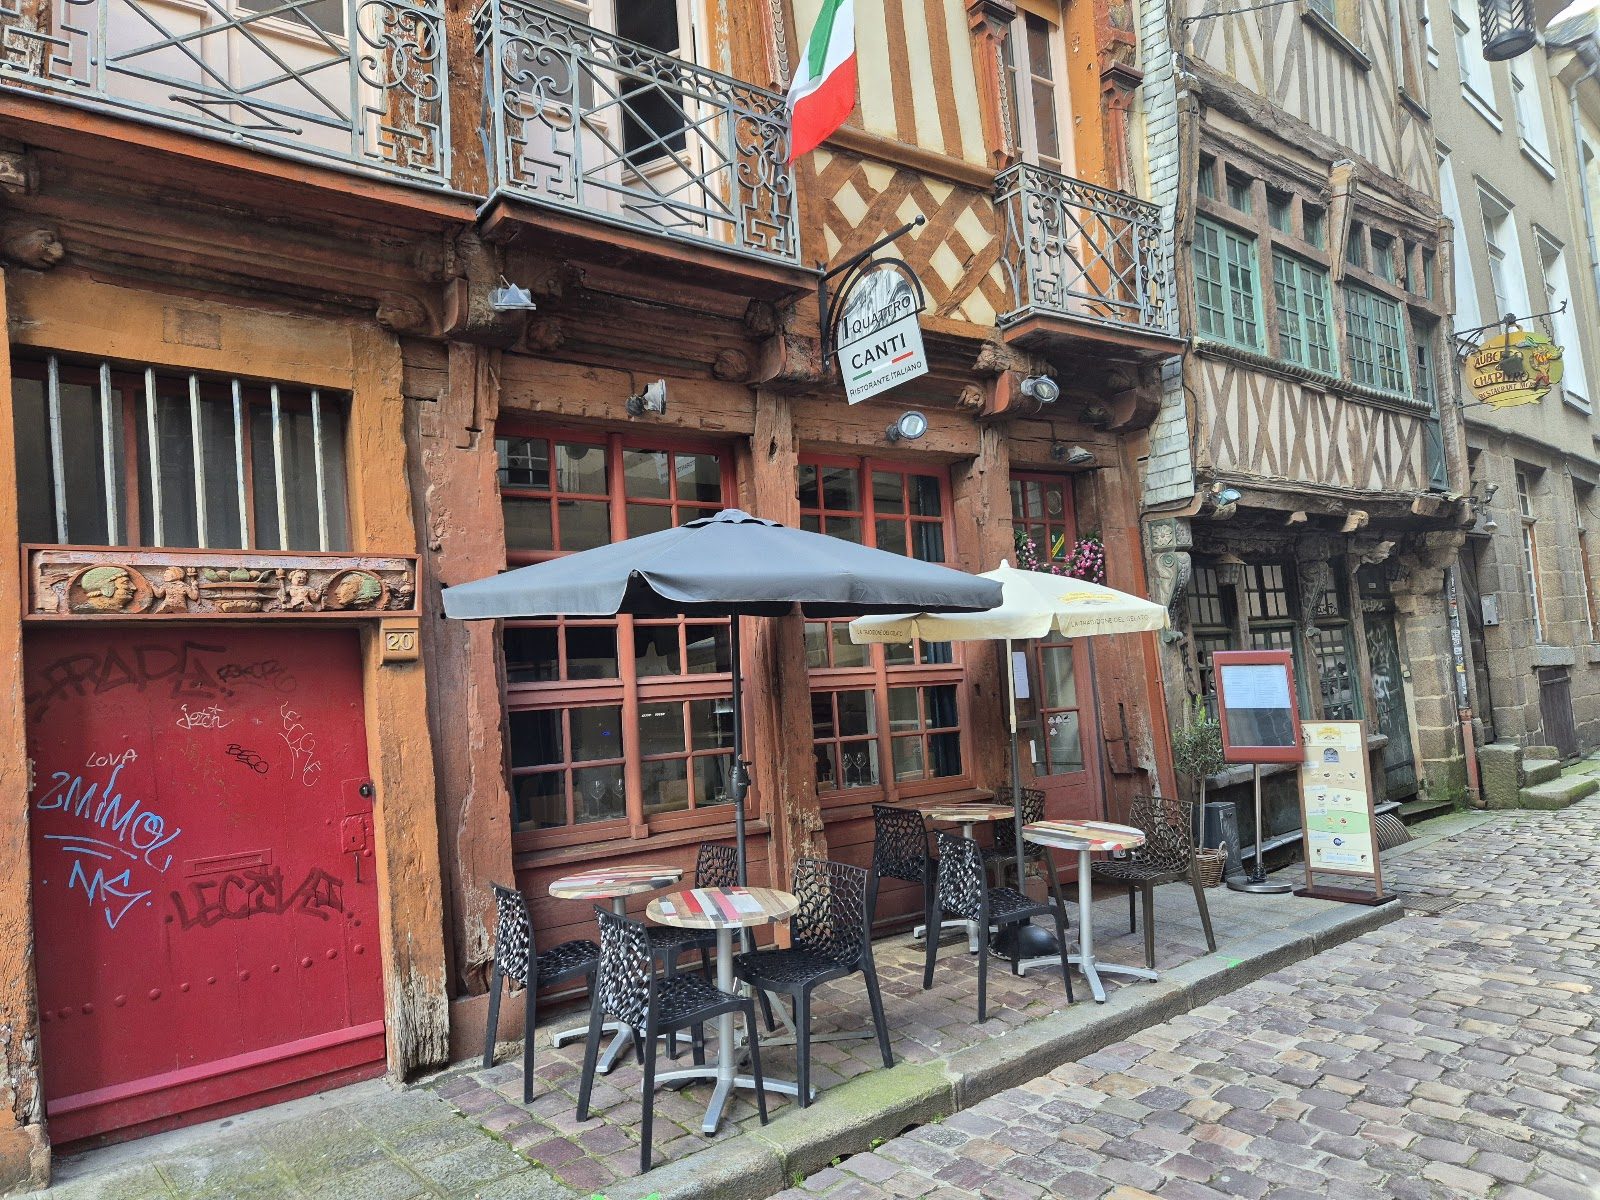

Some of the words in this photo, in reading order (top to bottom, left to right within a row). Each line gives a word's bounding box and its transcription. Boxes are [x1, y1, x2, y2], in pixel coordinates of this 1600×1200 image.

[843, 317, 849, 339] I
[852, 295, 911, 334] QUATTRO
[851, 333, 907, 370] CANTI
[850, 374, 891, 397] RISTORANTE
[890, 361, 922, 380] ITALIANO
[1478, 383, 1517, 399] RESTAURANT
[387, 633, 414, 650] 20
